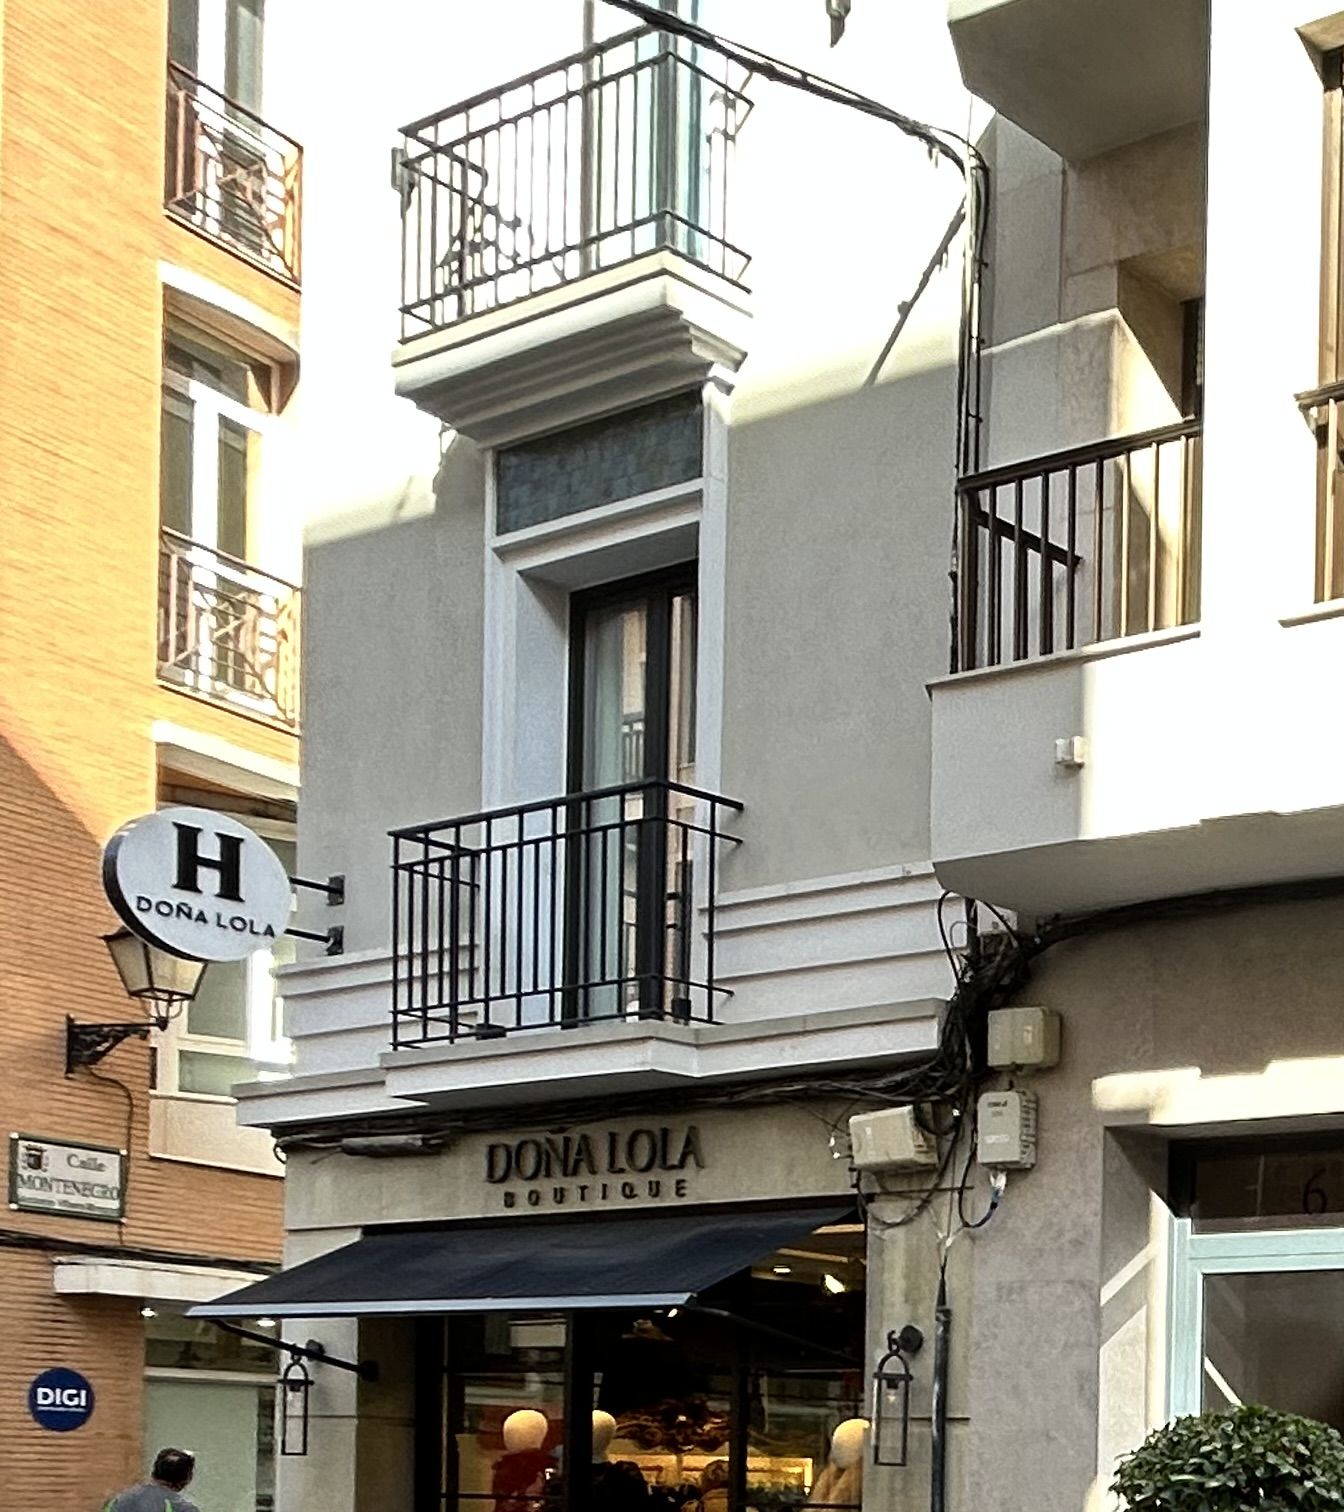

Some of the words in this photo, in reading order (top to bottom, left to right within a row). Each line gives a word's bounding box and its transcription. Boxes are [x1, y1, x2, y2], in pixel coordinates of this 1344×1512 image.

[171, 821, 245, 903] H
[136, 895, 208, 924] DOÑA
[216, 912, 275, 939] LOLA
[485, 1126, 598, 1184] DOÑA
[607, 1125, 705, 1174] LOLA
[503, 1178, 688, 1208] BOUTIQUE
[1303, 1168, 1328, 1215] 6
[37, 1387, 87, 1407] DIGI
